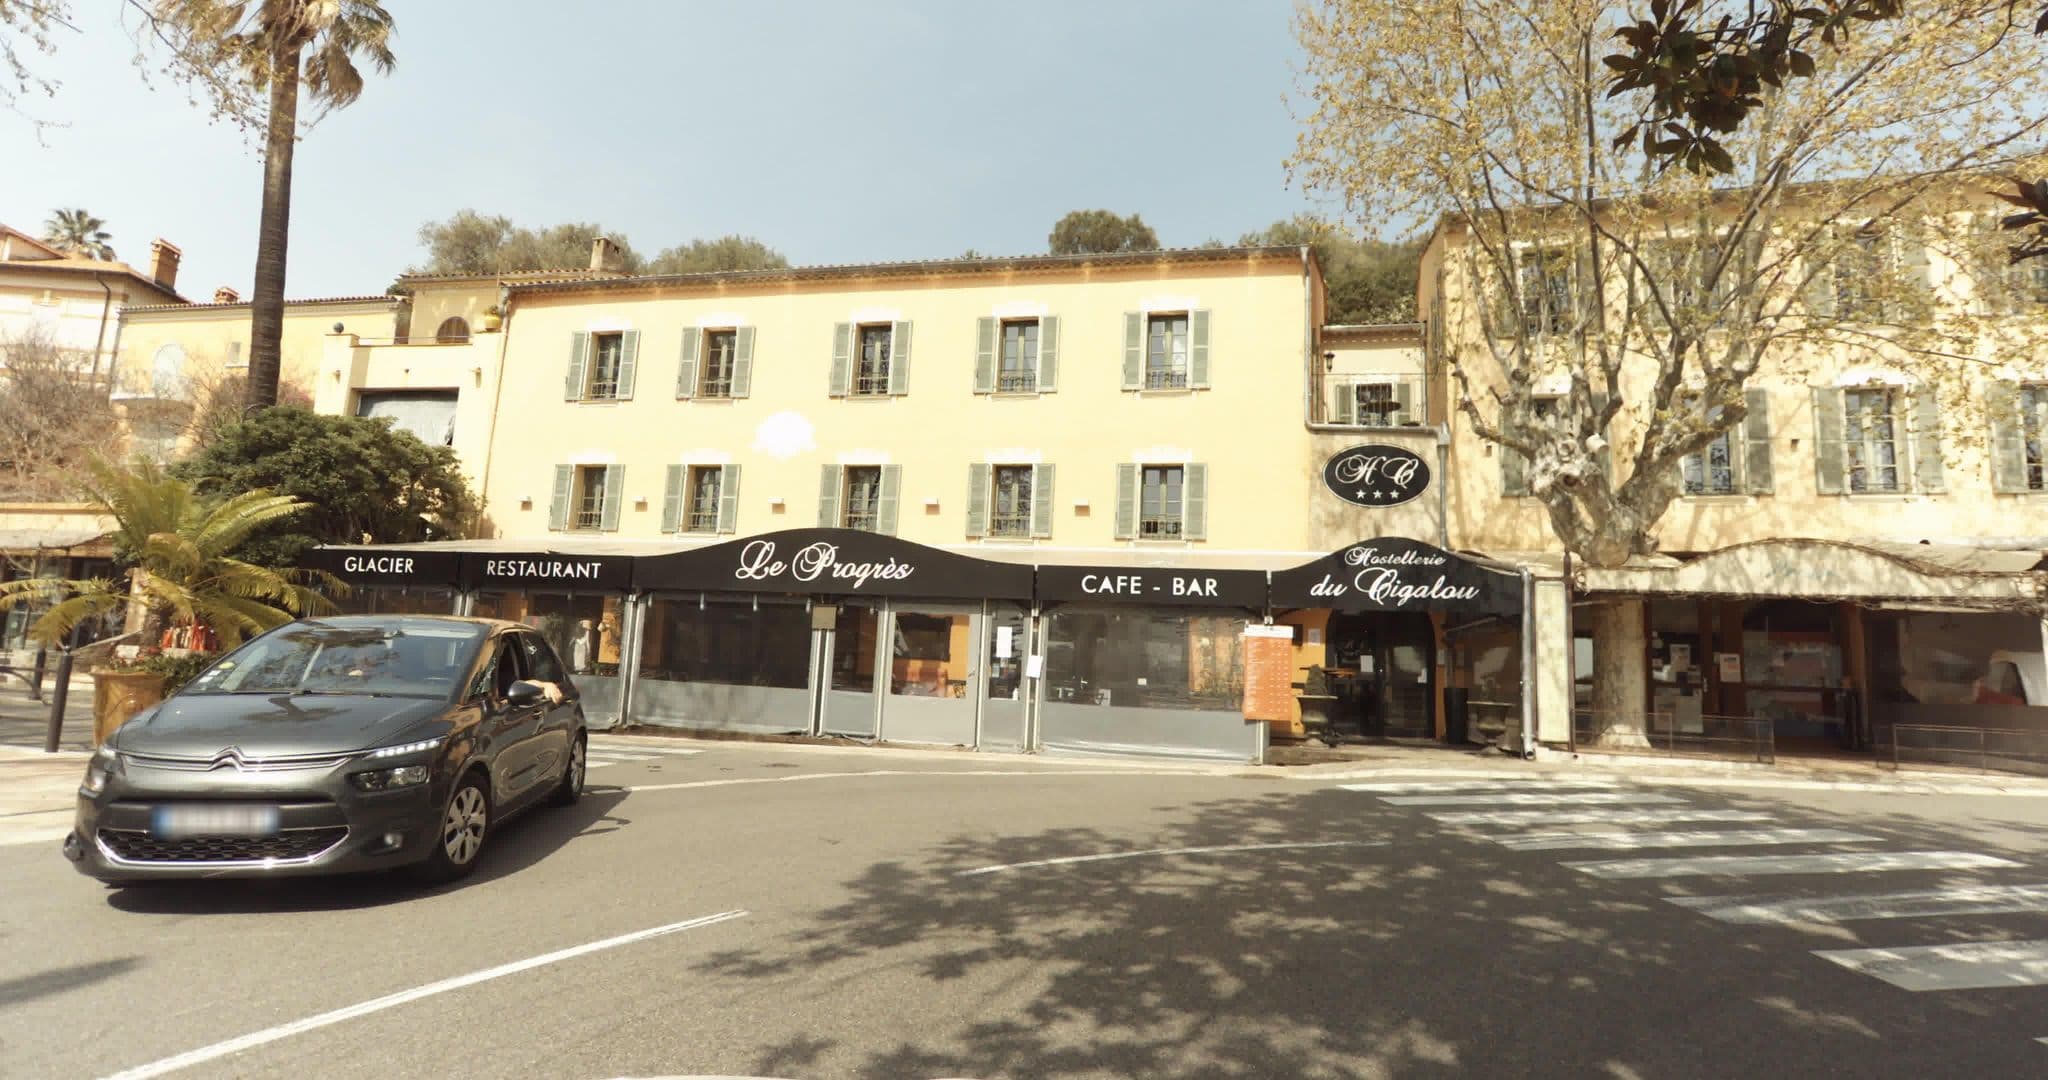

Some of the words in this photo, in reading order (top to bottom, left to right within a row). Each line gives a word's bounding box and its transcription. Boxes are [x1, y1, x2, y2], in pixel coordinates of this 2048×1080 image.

[344, 556, 414, 574] GLACIER
[735, 540, 787, 580] Le
[792, 542, 915, 589] Progrès
[1344, 546, 1447, 566] Hostellerie
[487, 560, 602, 579] RESTAURANT
[1081, 574, 1142, 595] CAFE
[1172, 577, 1218, 597] BAR
[1310, 574, 1347, 597] du
[1354, 567, 1480, 607] Cigalou
